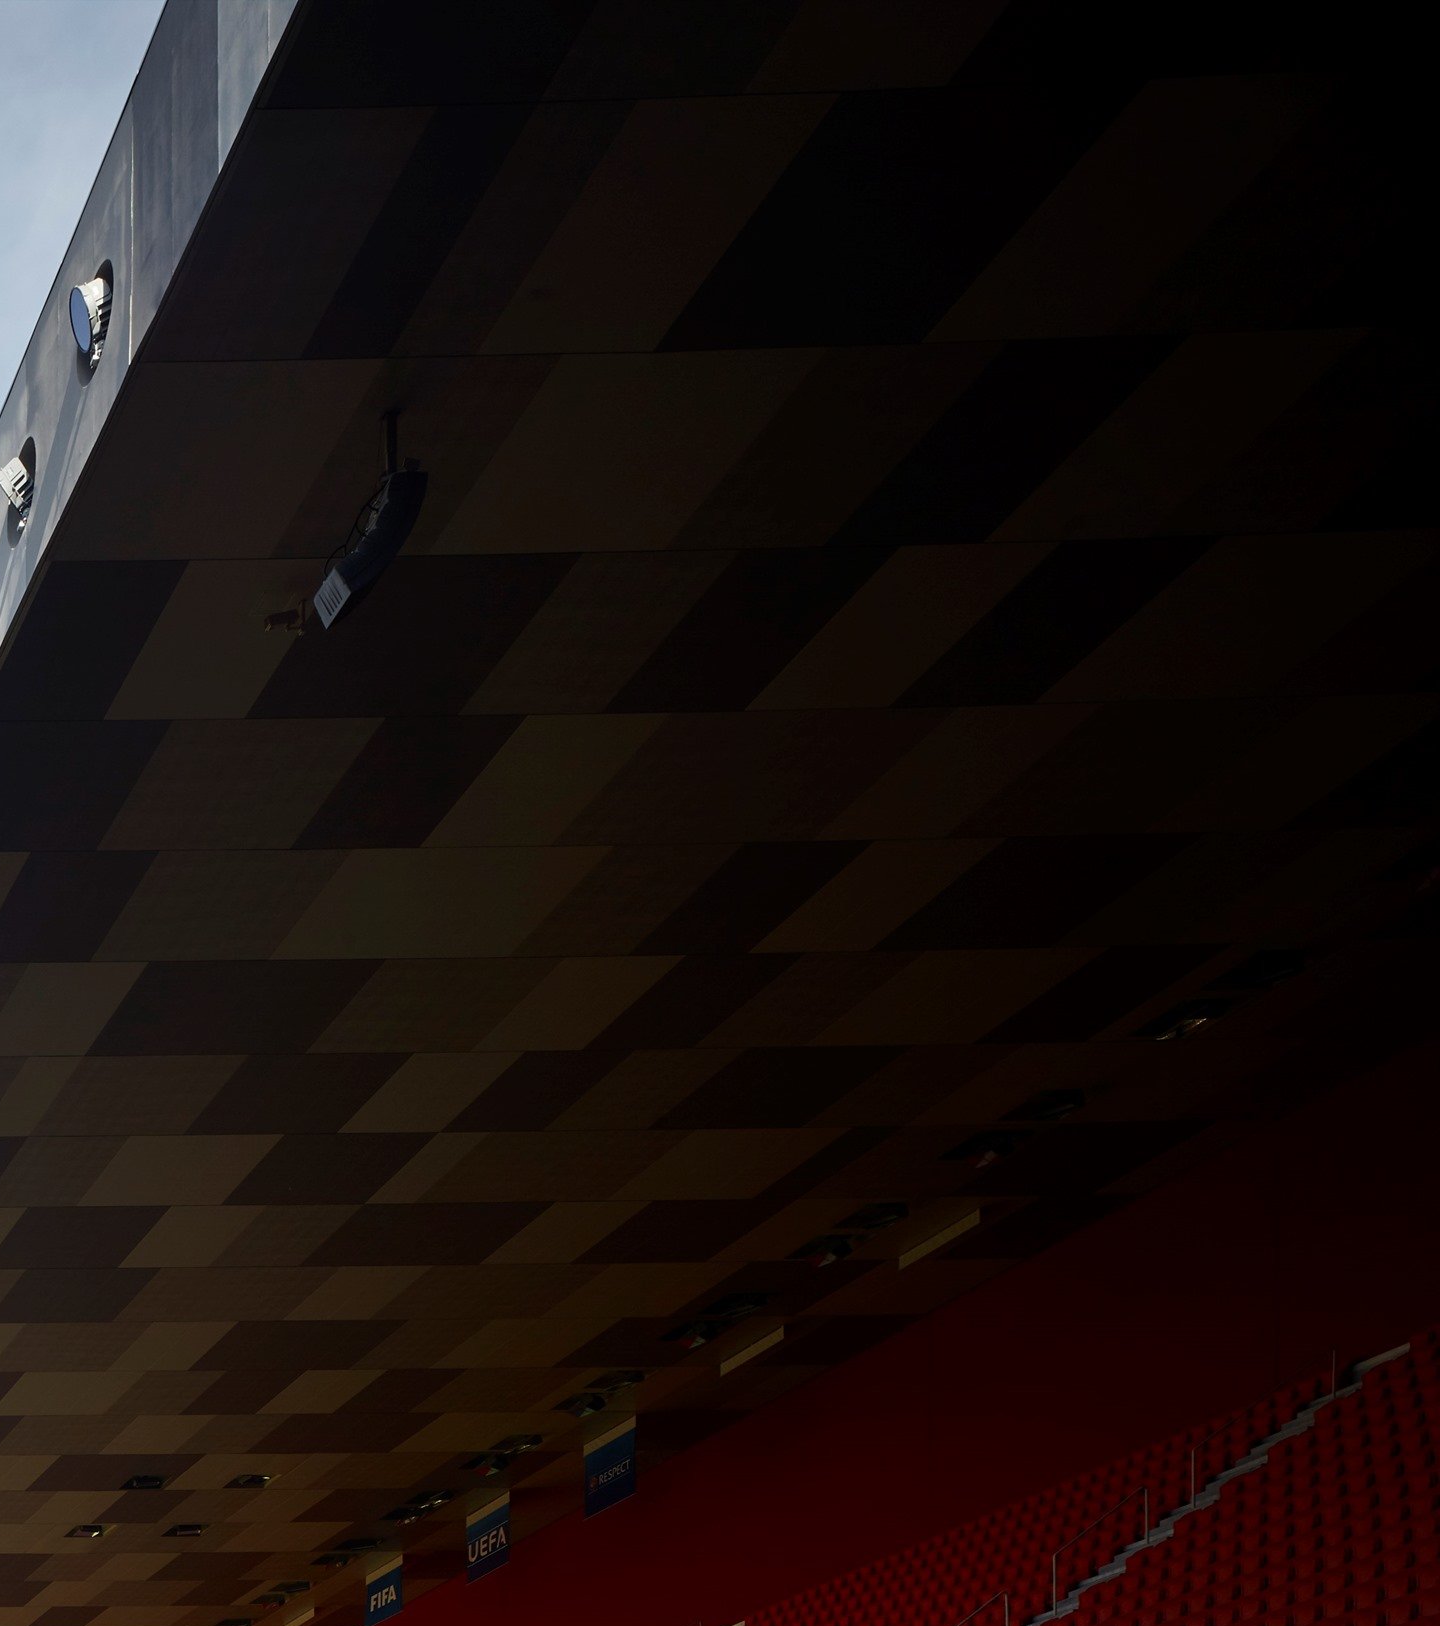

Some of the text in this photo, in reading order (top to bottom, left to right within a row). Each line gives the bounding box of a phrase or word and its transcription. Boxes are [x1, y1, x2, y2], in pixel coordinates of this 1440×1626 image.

[597, 1459, 631, 1485] RESPECT
[467, 1527, 507, 1563] UEFA
[369, 1585, 397, 1613] FIFA
